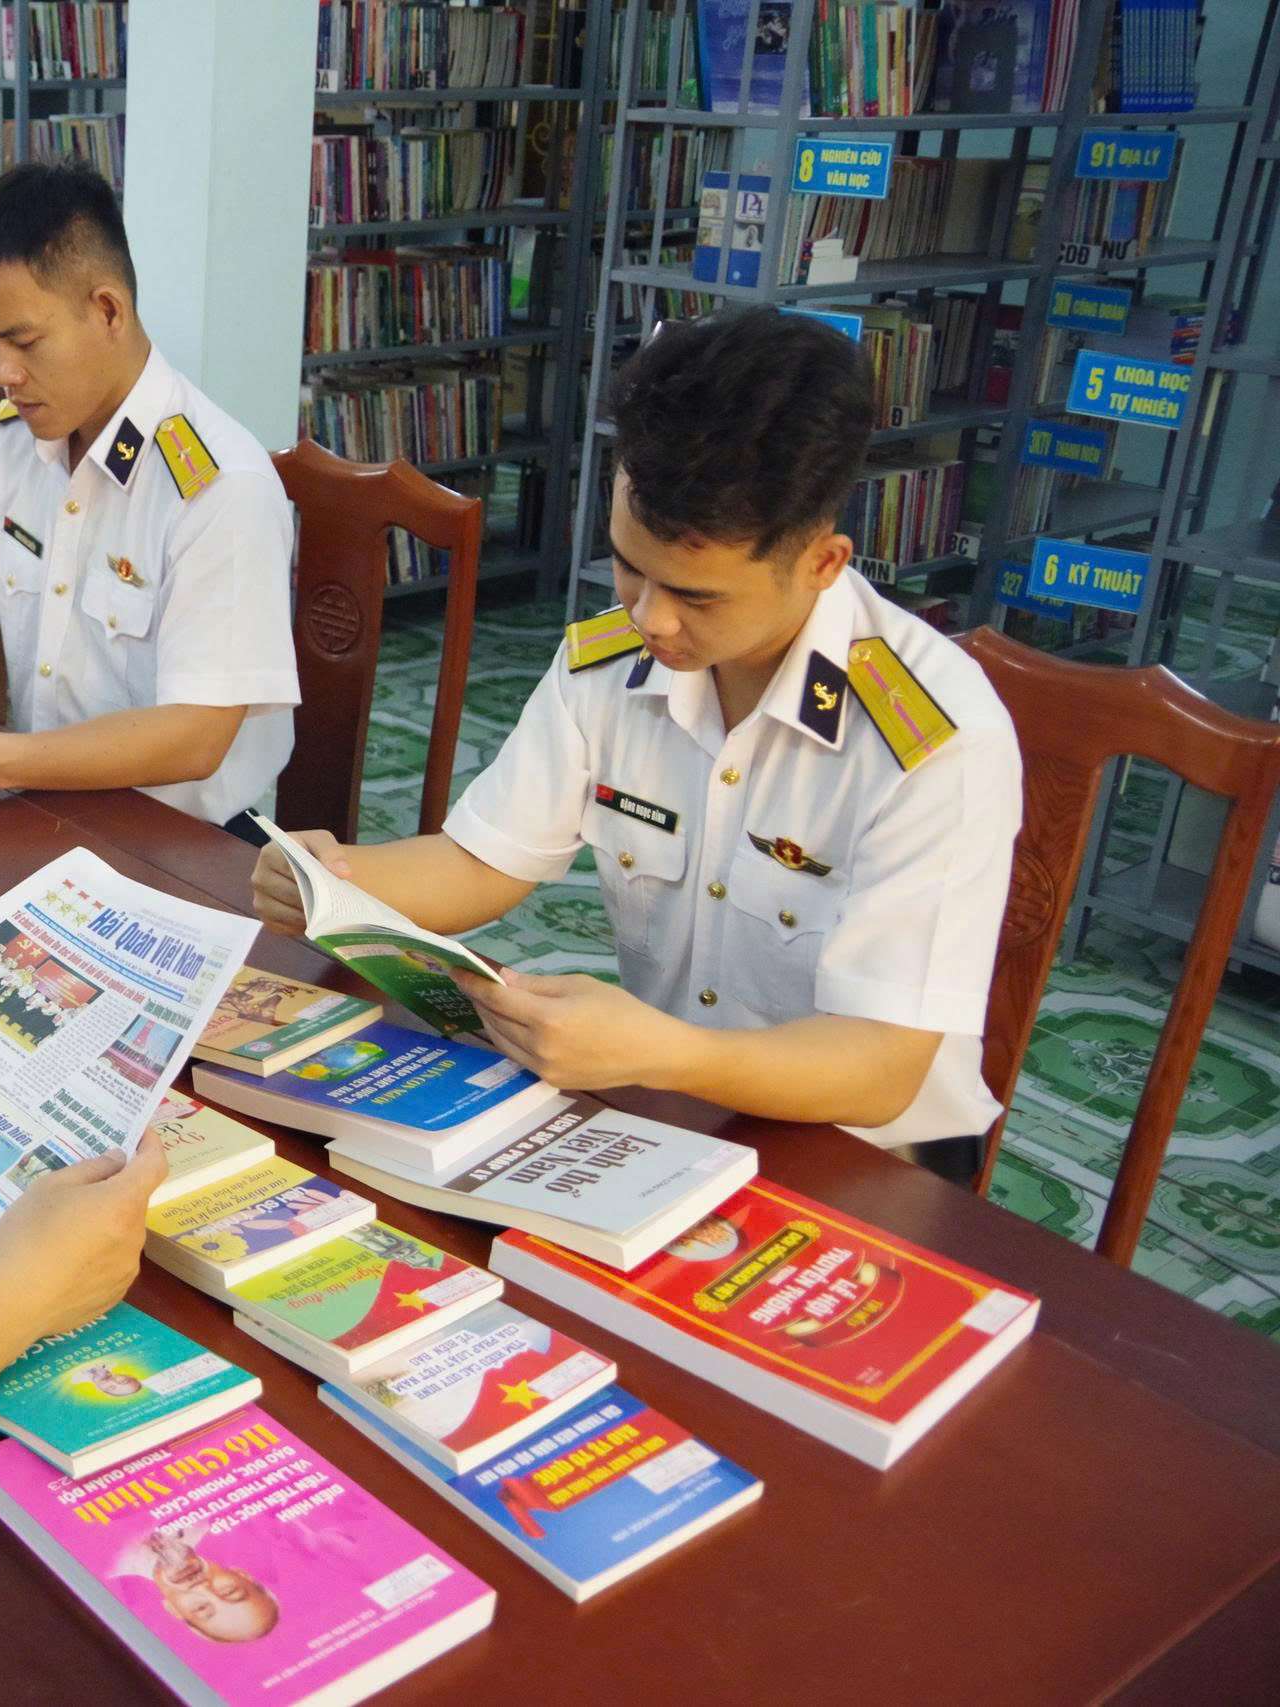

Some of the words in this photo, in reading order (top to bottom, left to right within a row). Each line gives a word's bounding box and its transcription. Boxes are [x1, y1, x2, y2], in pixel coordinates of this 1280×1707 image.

[820, 148, 858, 165] NGHIÊN
[860, 149, 883, 167] CỨU
[1090, 141, 1116, 167] 91
[1143, 148, 1161, 166] LÝ
[799, 149, 815, 183] 8
[826, 170, 846, 186] VĂN
[848, 172, 870, 190] HỌC
[1085, 367, 1105, 400] 5
[1114, 365, 1154, 387] KHOA
[1158, 371, 1191, 393] HỌC
[1109, 392, 1131, 415] TỰ
[1130, 396, 1180, 419] NHIÊN
[1044, 554, 1060, 585] 6
[1068, 561, 1089, 586] KỸ
[1093, 567, 1143, 599] THUẬT
[85, 902, 130, 943] Hải
[113, 917, 161, 961] Quân
[145, 933, 183, 977] Việt
[171, 941, 208, 981] Nam
[386, 1051, 417, 1067] PHÁP
[408, 1045, 429, 1055] VÀ
[366, 1063, 394, 1077] LUẬT
[392, 1061, 422, 1077] PHÁP
[325, 1084, 353, 1098] NAM
[346, 1074, 374, 1088] VIỆT
[369, 1073, 400, 1088] LUẬT
[399, 1075, 427, 1090] CON
[539, 1111, 584, 1134] LỊCH
[513, 1141, 536, 1151] &
[525, 1130, 559, 1145] SỬ
[550, 1122, 624, 1157] Việt
[481, 1147, 528, 1171] PHÁP
[581, 1133, 661, 1173] Lãnh
[243, 1166, 275, 1184] trong
[465, 1167, 495, 1181] LÝ
[503, 1150, 580, 1188] Nam
[267, 1176, 289, 1189] của
[273, 1183, 309, 1203] LỊCH
[540, 1167, 608, 1198] thổ
[159, 1203, 191, 1220] Nam
[188, 1194, 213, 1208] Việt
[755, 1242, 791, 1267] SỐNG
[790, 1243, 860, 1292] TRUYỀN
[710, 1280, 741, 1301] VIỆT
[825, 1276, 865, 1302] LỄ
[746, 1282, 812, 1328] THỐNG
[798, 1289, 845, 1321] HỘI
[92, 1330, 126, 1347] CHO
[454, 1331, 474, 1344] VỀ
[494, 1324, 520, 1340] CỦA
[51, 1345, 95, 1365] QUỐC
[431, 1338, 459, 1356] BIỂN
[468, 1334, 499, 1355] PHÁP
[501, 1337, 526, 1354] TÌM
[407, 1351, 433, 1368] ĐẢO
[441, 1347, 474, 1368] LUẬT
[477, 1349, 507, 1368] HIỂU
[415, 1361, 446, 1381] VIỆT
[436, 1370, 463, 1387] QUY
[458, 1361, 483, 1378] CÁC
[391, 1375, 420, 1393] NAM
[411, 1381, 442, 1401] ĐỊNH
[218, 1422, 285, 1462] Hồ
[603, 1422, 643, 1447] BẢO
[260, 1442, 298, 1464] ĐẠO
[584, 1437, 615, 1457] VỆ
[119, 1447, 173, 1475] TRONG
[159, 1443, 236, 1487] Chí
[229, 1457, 270, 1479] ĐỨC,
[285, 1457, 314, 1474] VÀ
[565, 1447, 598, 1469] TỔ
[80, 1468, 128, 1494] QUÂN
[258, 1465, 296, 1486] LÀM
[292, 1469, 331, 1491] TIÊN
[529, 1458, 578, 1488] QUỐC
[184, 1472, 238, 1500] PHONG
[223, 1479, 265, 1502] THEO
[260, 1484, 302, 1508] TIẾN
[306, 1482, 347, 1505] ĐIỂN
[69, 1471, 176, 1529] Minh
[146, 1494, 193, 1520] CÁCH
[204, 1496, 230, 1512] TƯ
[230, 1498, 266, 1519] HỌC
[273, 1499, 314, 1522] HÌNH
[151, 1505, 214, 1538] TƯỞNG,
[201, 1513, 241, 1535] TẬP
